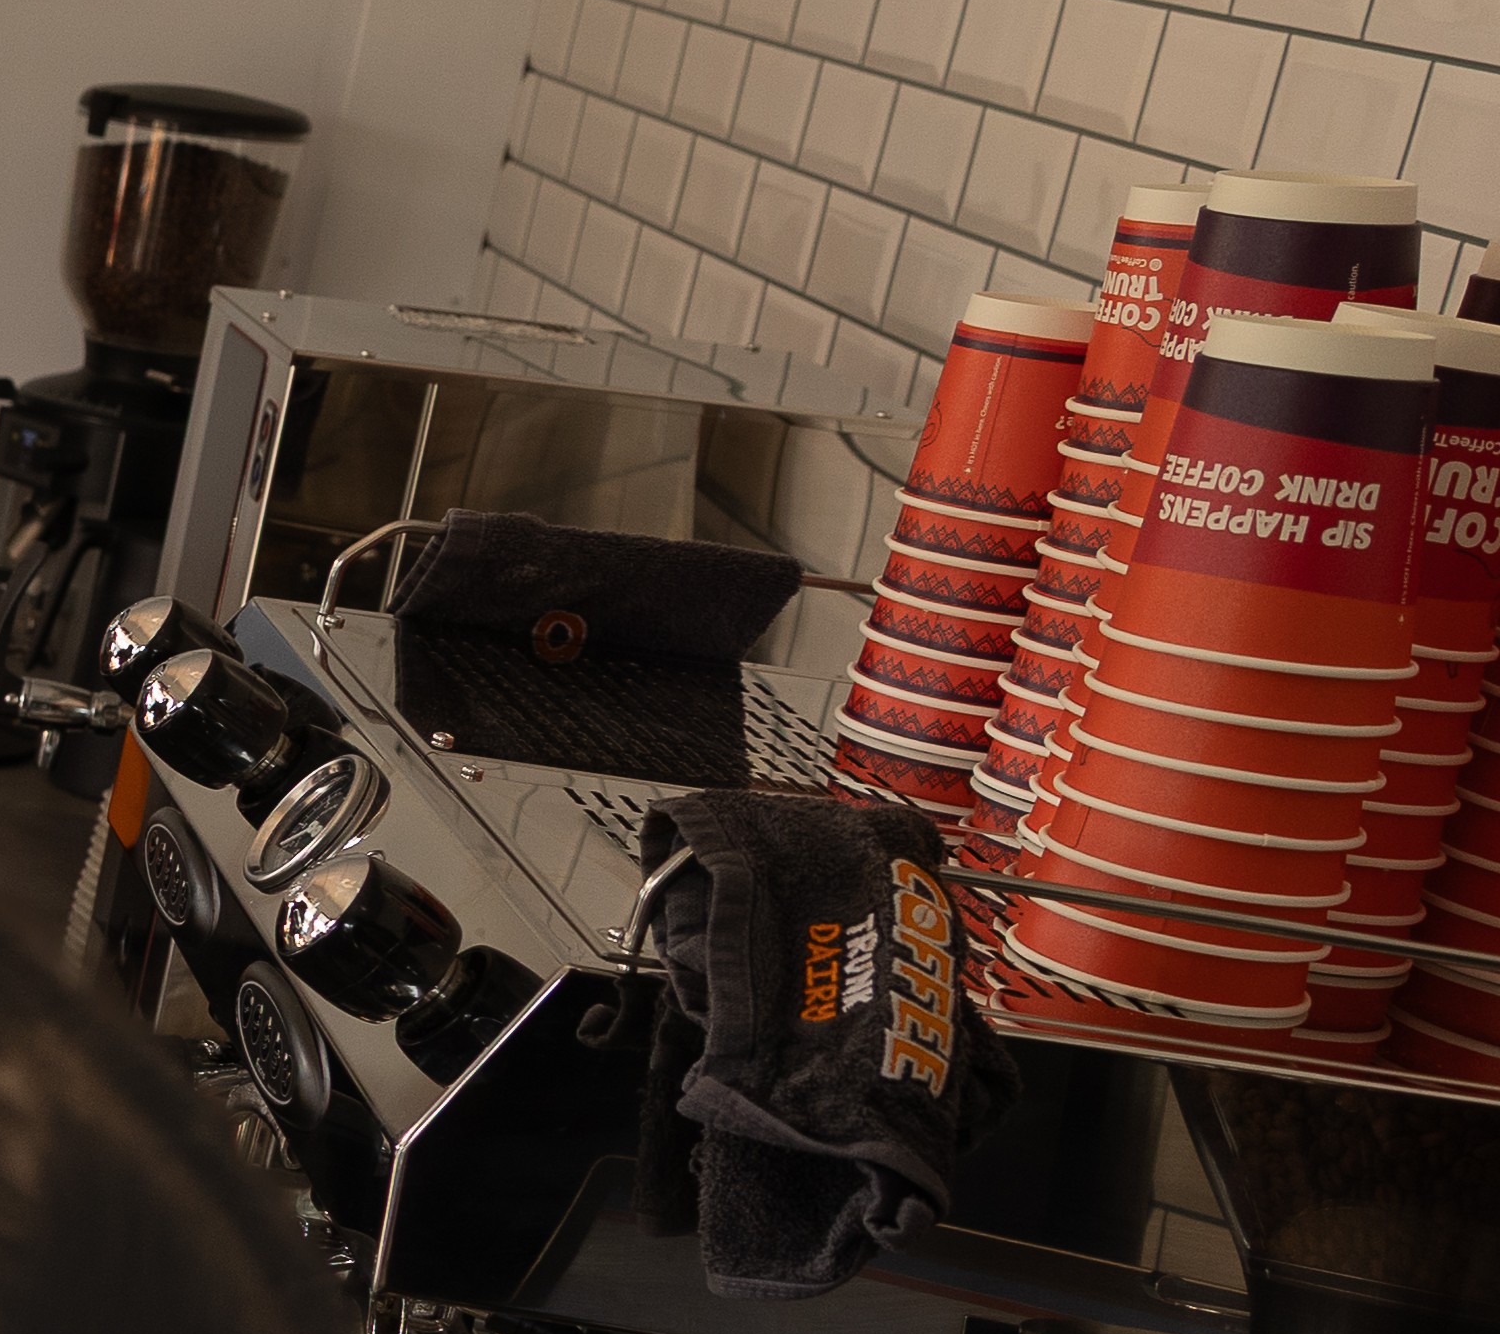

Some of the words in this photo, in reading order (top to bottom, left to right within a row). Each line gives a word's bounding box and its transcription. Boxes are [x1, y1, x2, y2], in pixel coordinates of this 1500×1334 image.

[1094, 299, 1161, 331] COFFE
[1158, 492, 1310, 543] HAPPENS.
[1274, 473, 1381, 511] DRINK
[1320, 519, 1375, 550] SIP
[800, 922, 843, 1023] DAIRY
[841, 912, 878, 1014] TRUNK
[882, 858, 955, 1098] COFFEE
